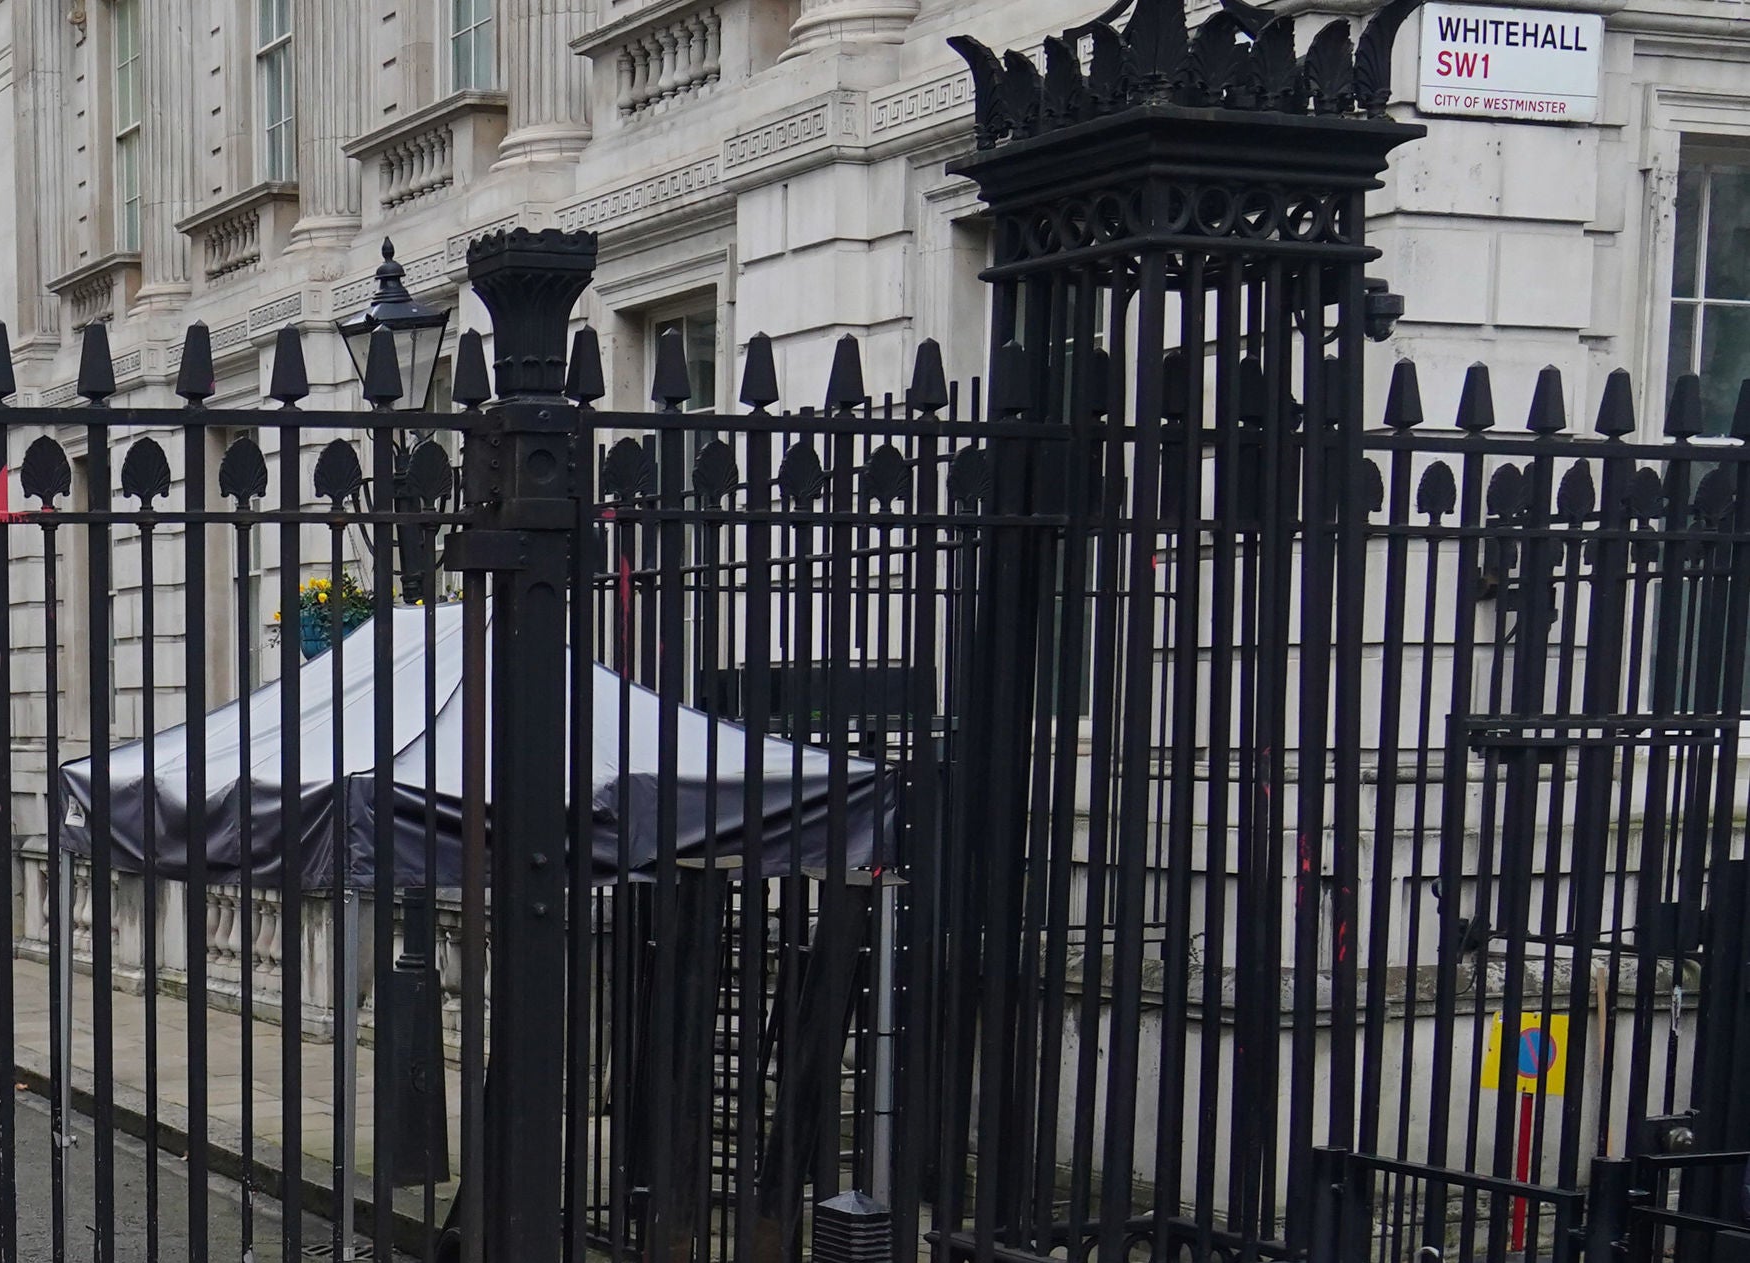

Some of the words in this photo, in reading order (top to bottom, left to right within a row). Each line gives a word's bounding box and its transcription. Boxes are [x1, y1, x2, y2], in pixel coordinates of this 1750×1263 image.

[1438, 16, 1587, 51] WHITEHALL
[1436, 51, 1490, 78] SW1
[1434, 94, 1460, 107] CITY
[1464, 96, 1480, 108] OF
[1483, 97, 1566, 114] WESTMINSTER
